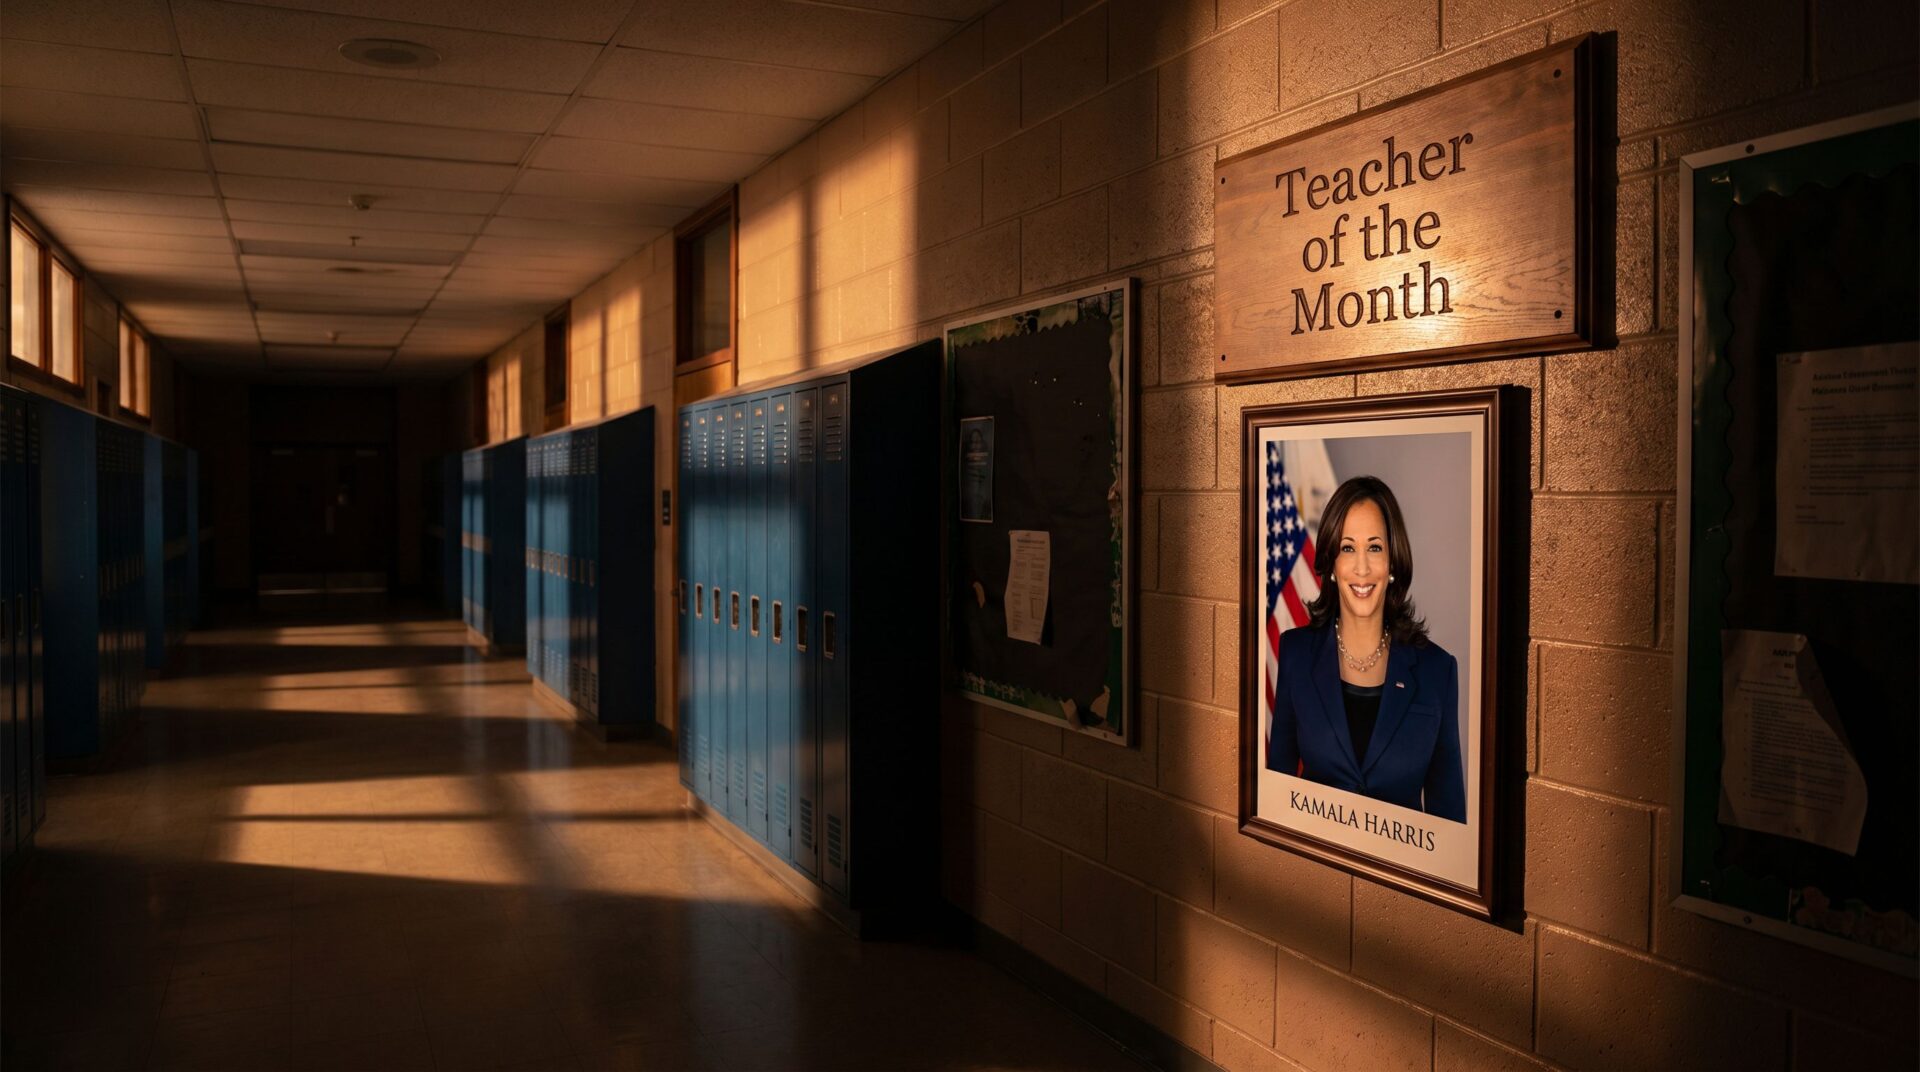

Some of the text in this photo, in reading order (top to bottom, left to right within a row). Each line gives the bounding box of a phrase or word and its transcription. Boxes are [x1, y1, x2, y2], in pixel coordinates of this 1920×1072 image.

[1275, 132, 1474, 218] Teacher
[1302, 203, 1441, 273] of the
[1290, 261, 1454, 336] Month
[1290, 790, 1435, 852] KAMALA HARRIS
